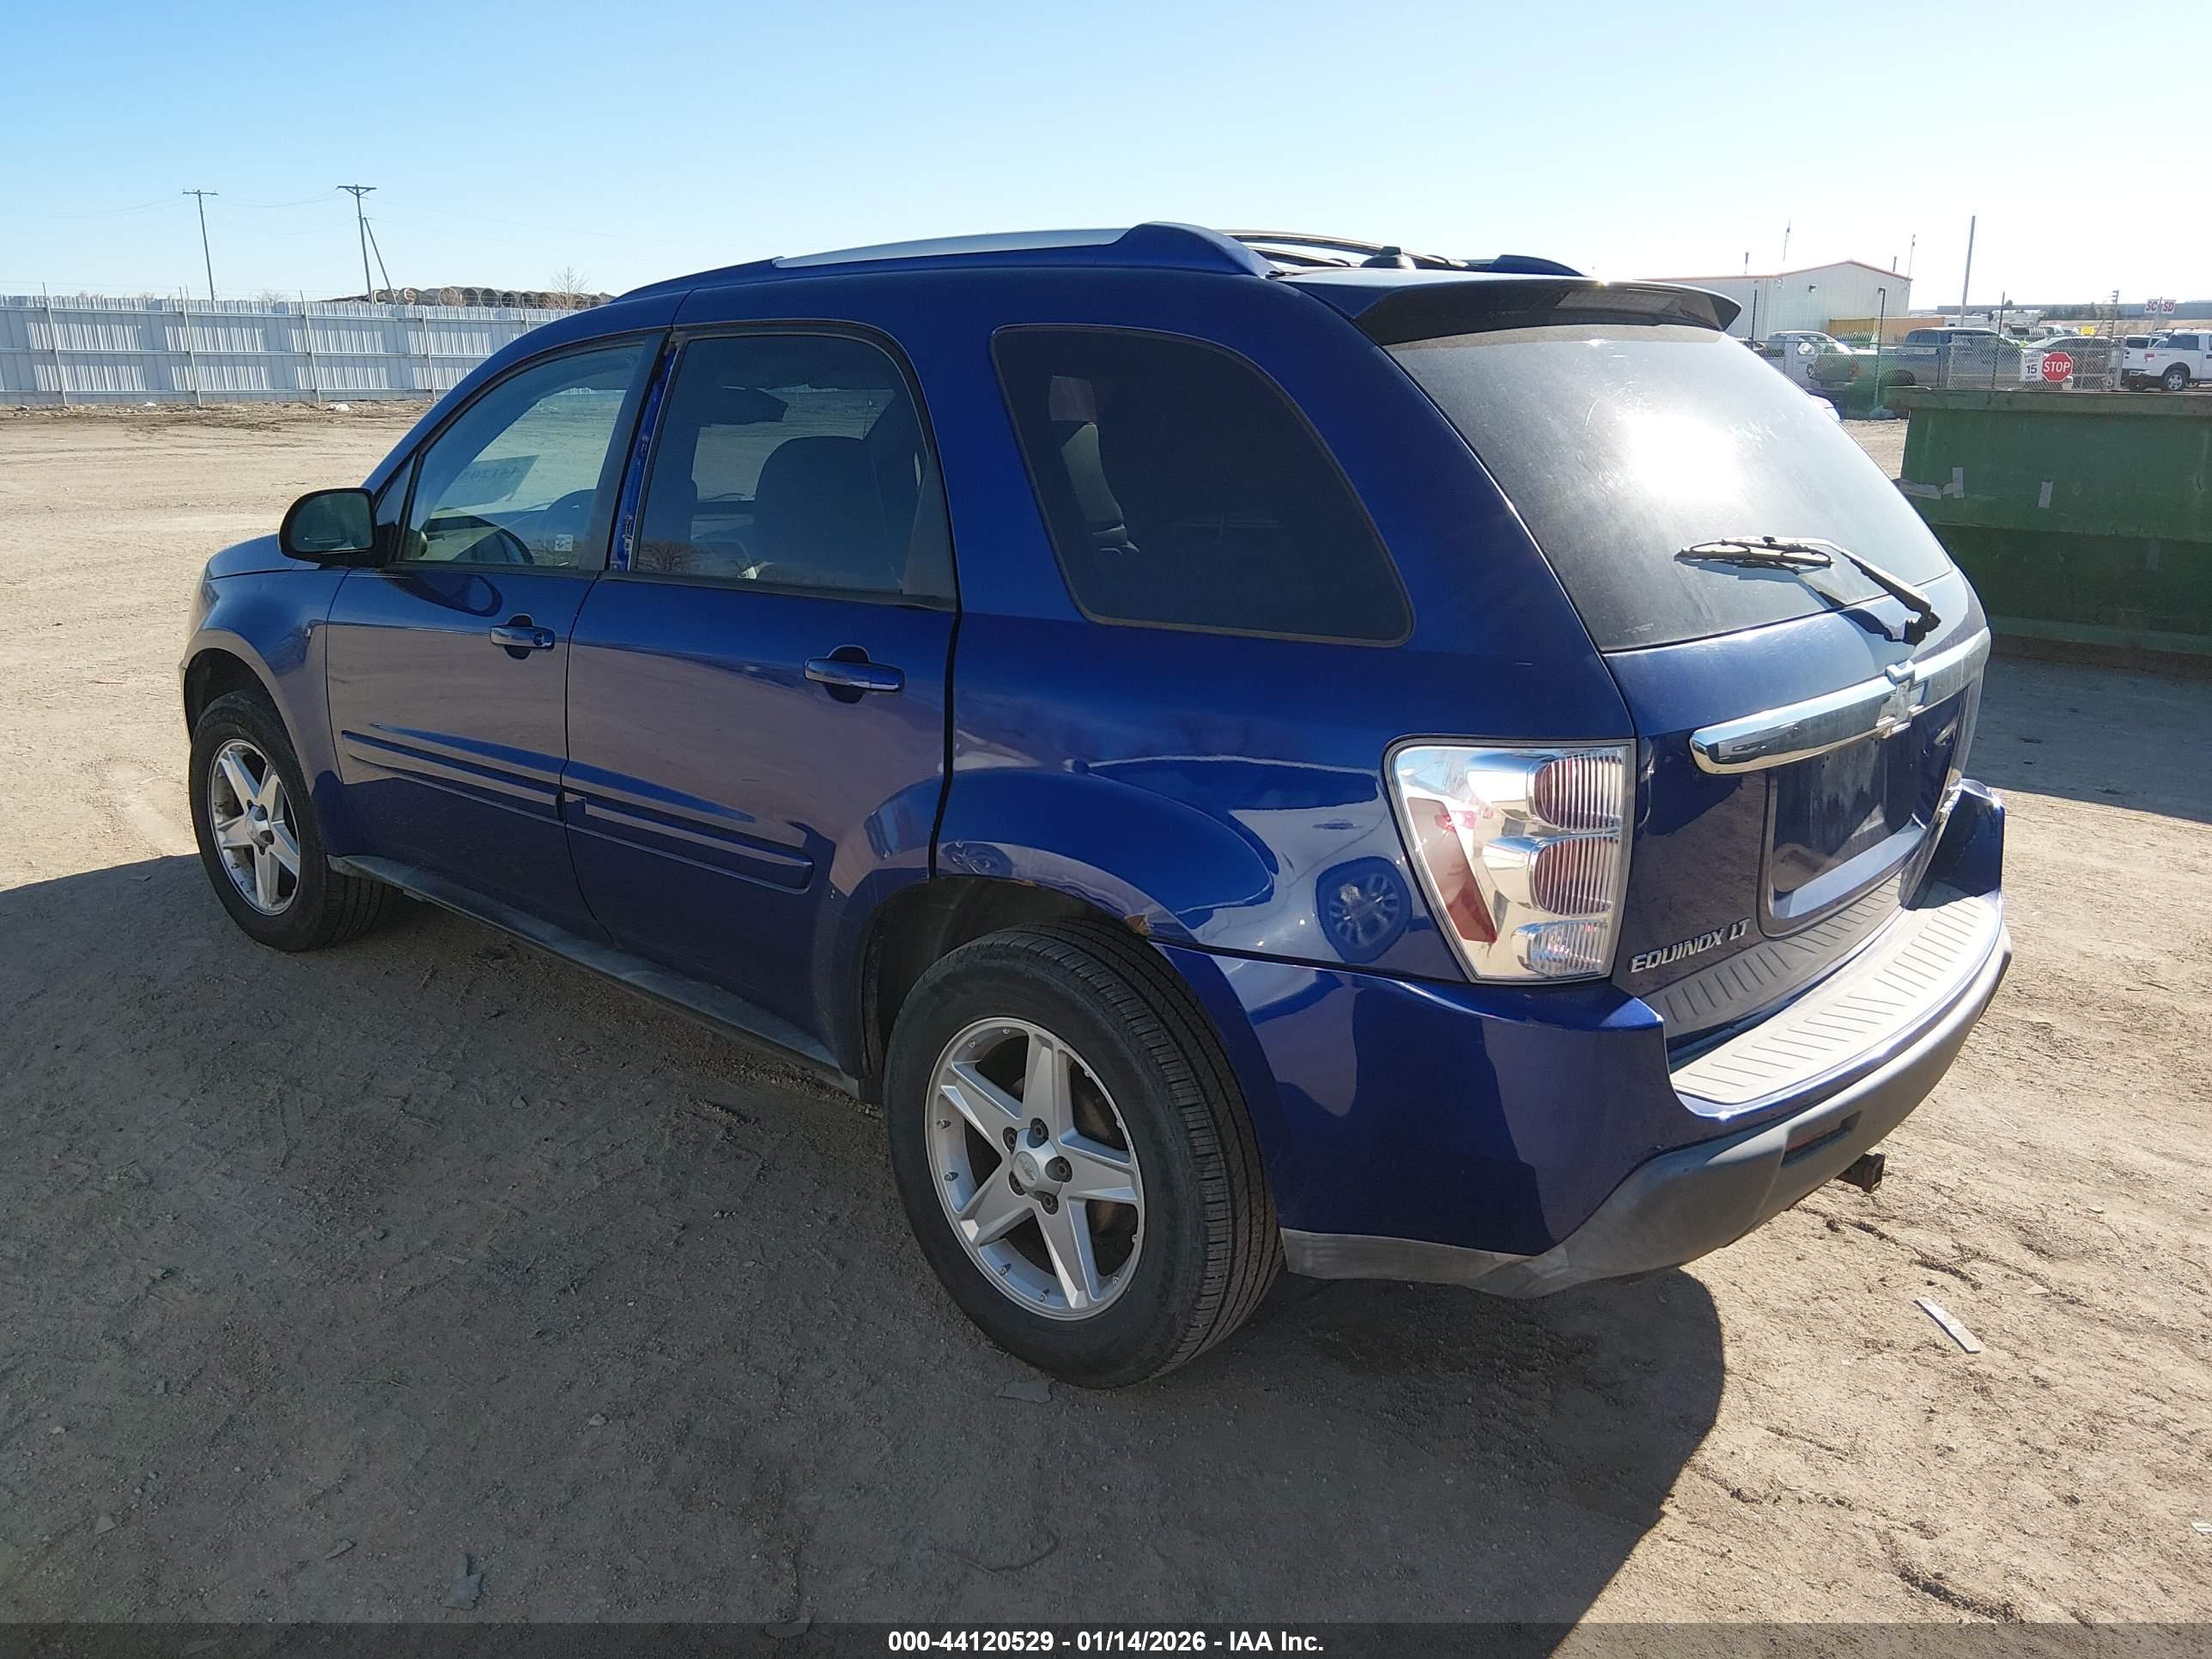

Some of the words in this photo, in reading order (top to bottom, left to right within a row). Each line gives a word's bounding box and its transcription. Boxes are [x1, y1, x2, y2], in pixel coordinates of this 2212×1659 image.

[2027, 364, 2038, 374] 15
[2044, 362, 2070, 373] STOP
[1630, 927, 1725, 974] EQUINOX
[1729, 918, 1752, 941] LT
